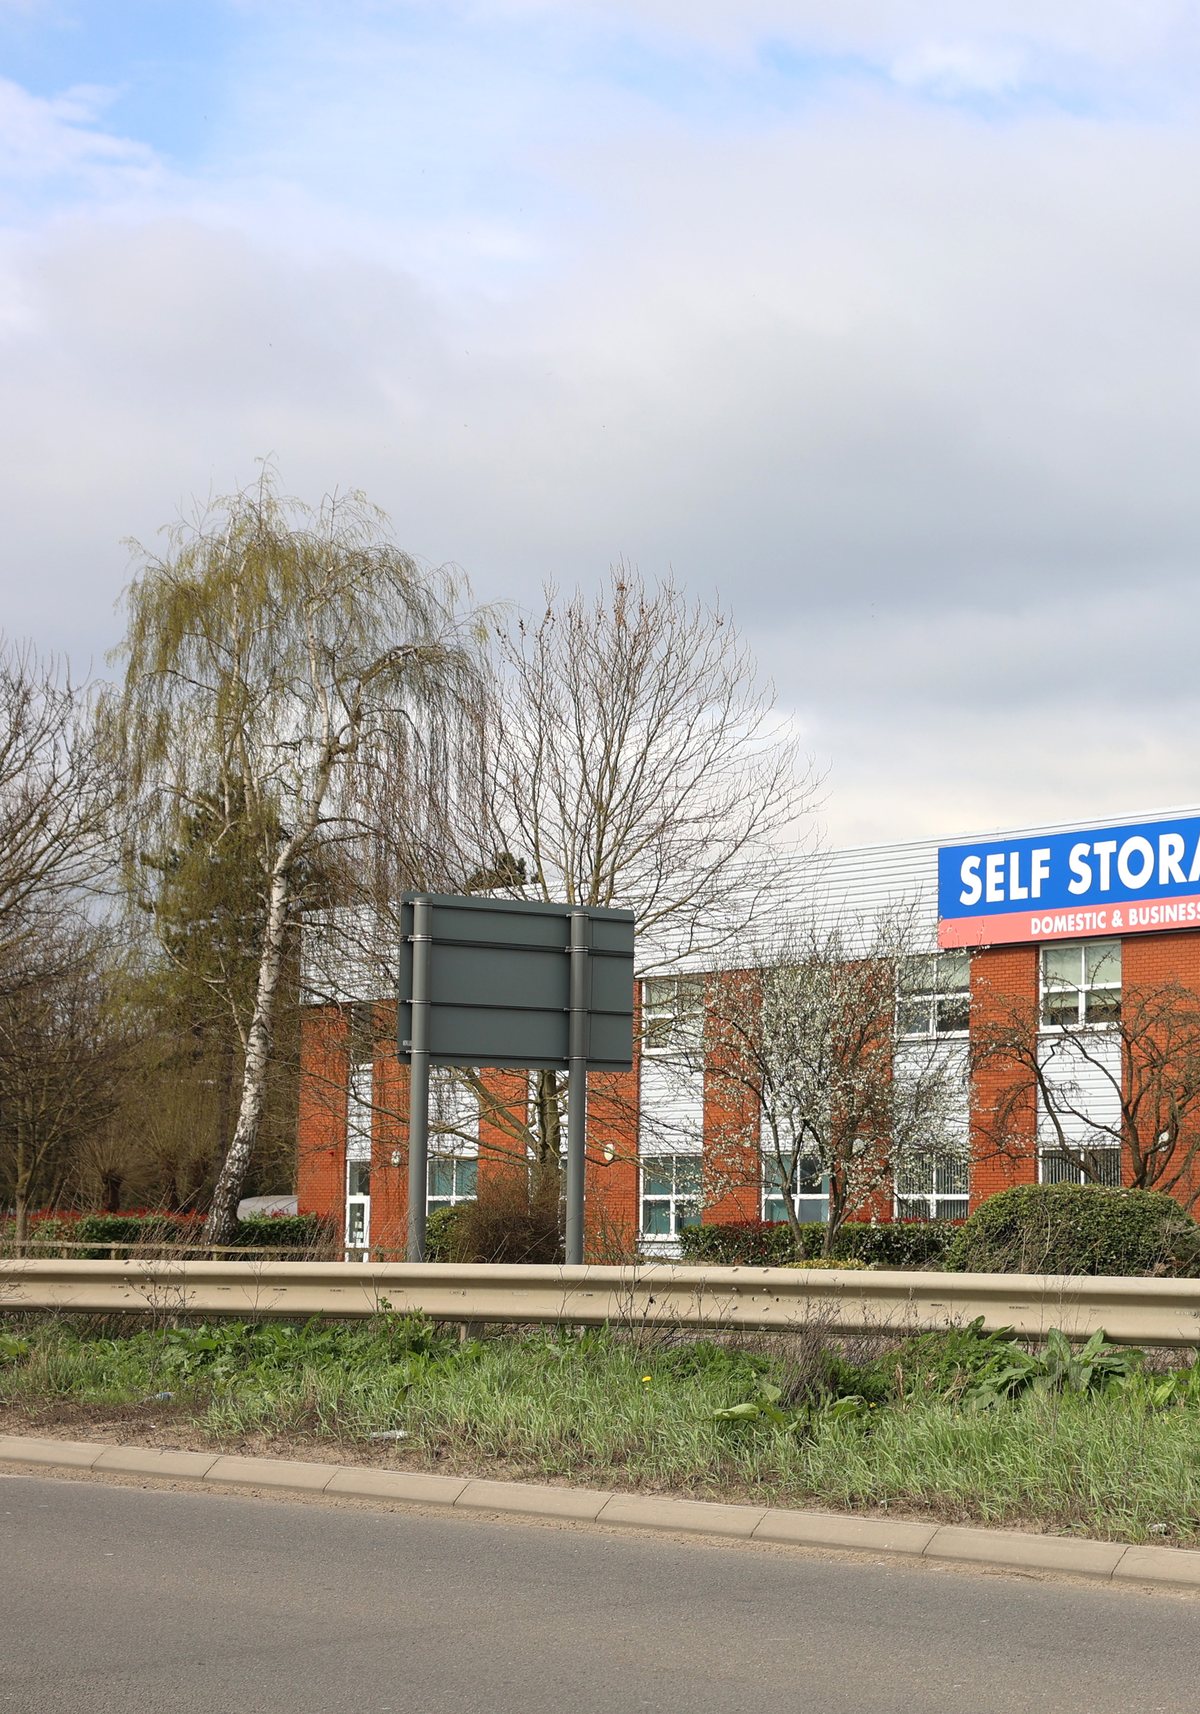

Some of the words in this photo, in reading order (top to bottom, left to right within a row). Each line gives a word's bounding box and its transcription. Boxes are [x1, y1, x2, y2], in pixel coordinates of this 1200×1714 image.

[959, 847, 1051, 906] SELF
[1030, 910, 1107, 935] DOMESTIC
[1111, 910, 1124, 928] &
